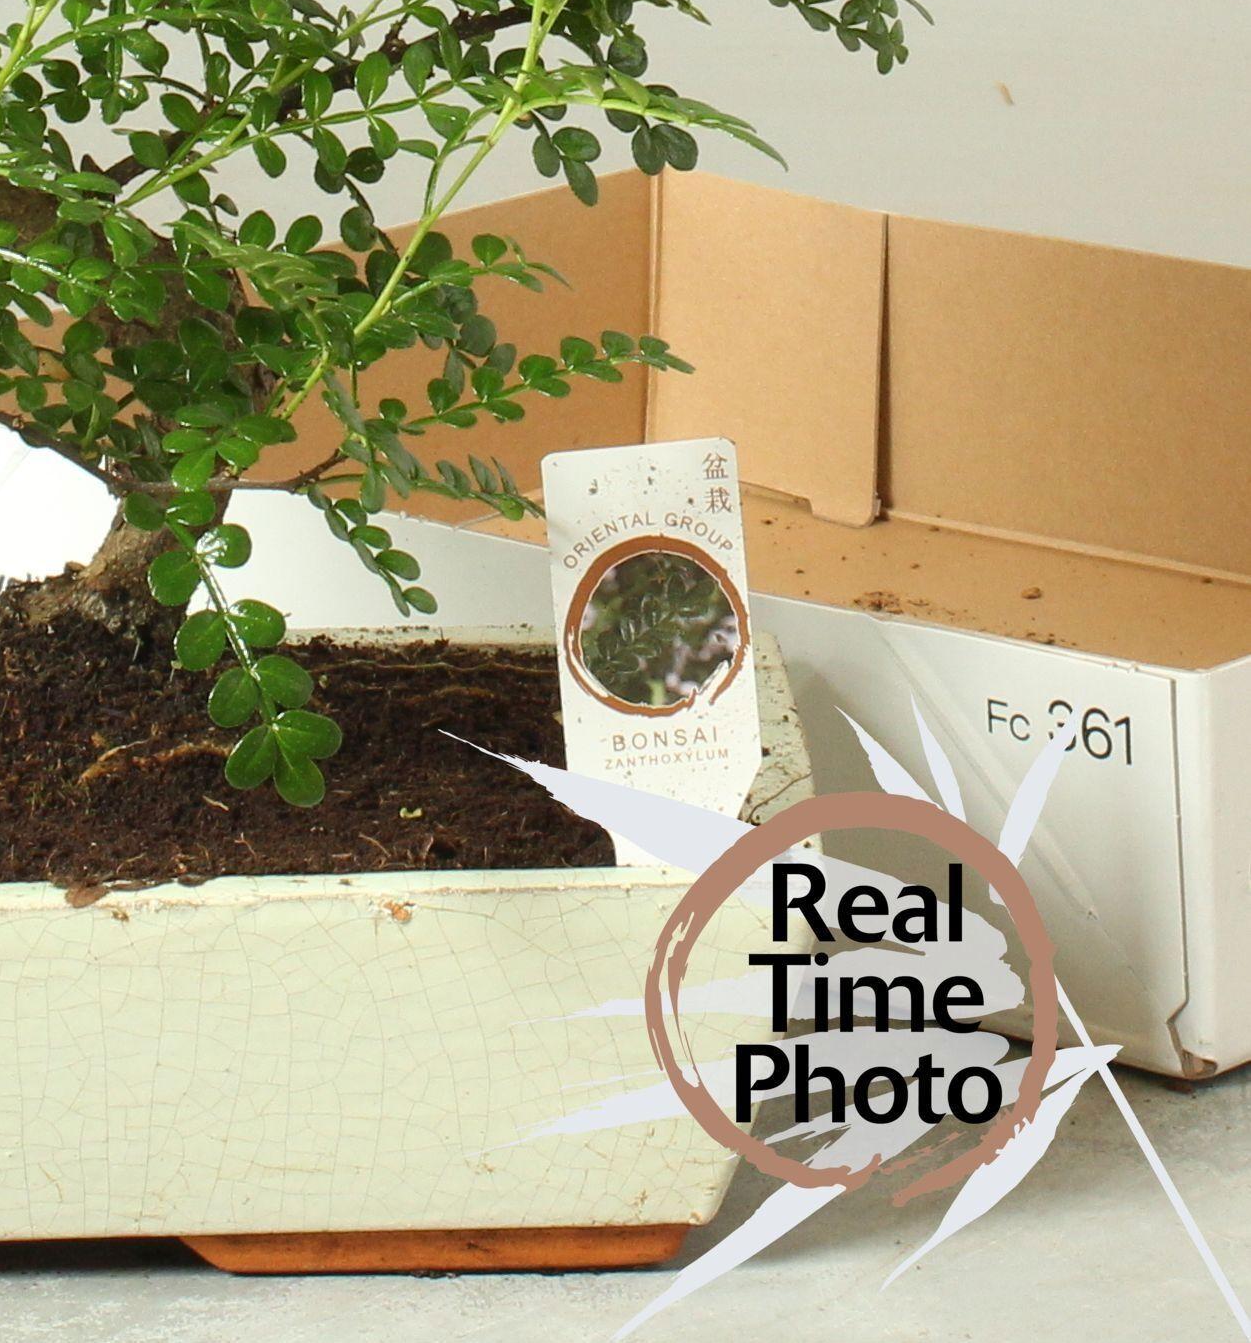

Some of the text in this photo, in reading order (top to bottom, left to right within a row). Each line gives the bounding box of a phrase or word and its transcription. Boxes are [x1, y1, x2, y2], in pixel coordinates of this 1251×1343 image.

[702, 452, 733, 514] 盆栽
[563, 511, 734, 570] ORIENTAL GROUP
[604, 748, 729, 770] ZANTHOXYLUM
[612, 726, 718, 752] BONSAI
